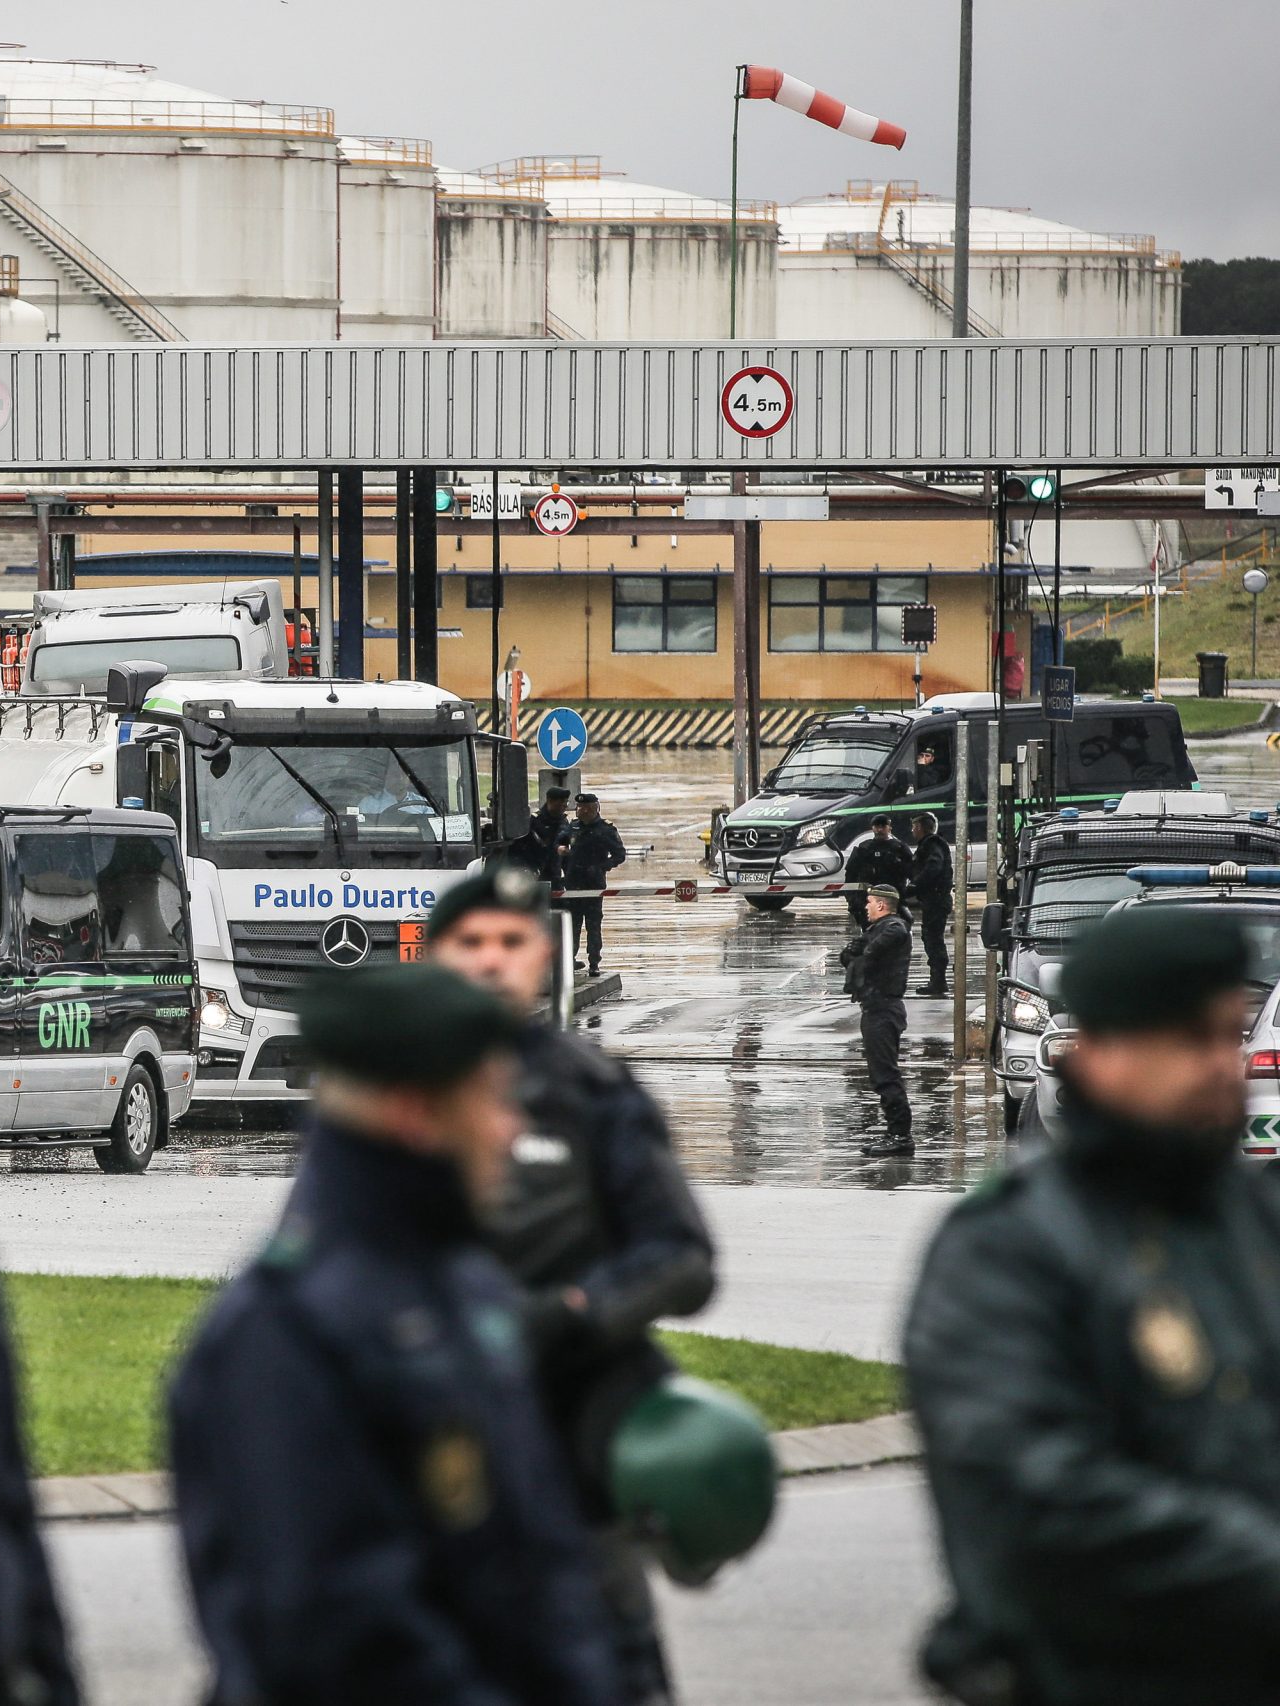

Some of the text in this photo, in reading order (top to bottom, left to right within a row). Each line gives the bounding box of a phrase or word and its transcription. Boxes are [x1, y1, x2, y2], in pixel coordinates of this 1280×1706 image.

[472, 489, 519, 513] BÁSULA
[747, 807, 790, 817] GNR
[254, 884, 436, 909] Paulo Duarte
[676, 887, 696, 896] STOP
[38, 1002, 91, 1049] GNR
